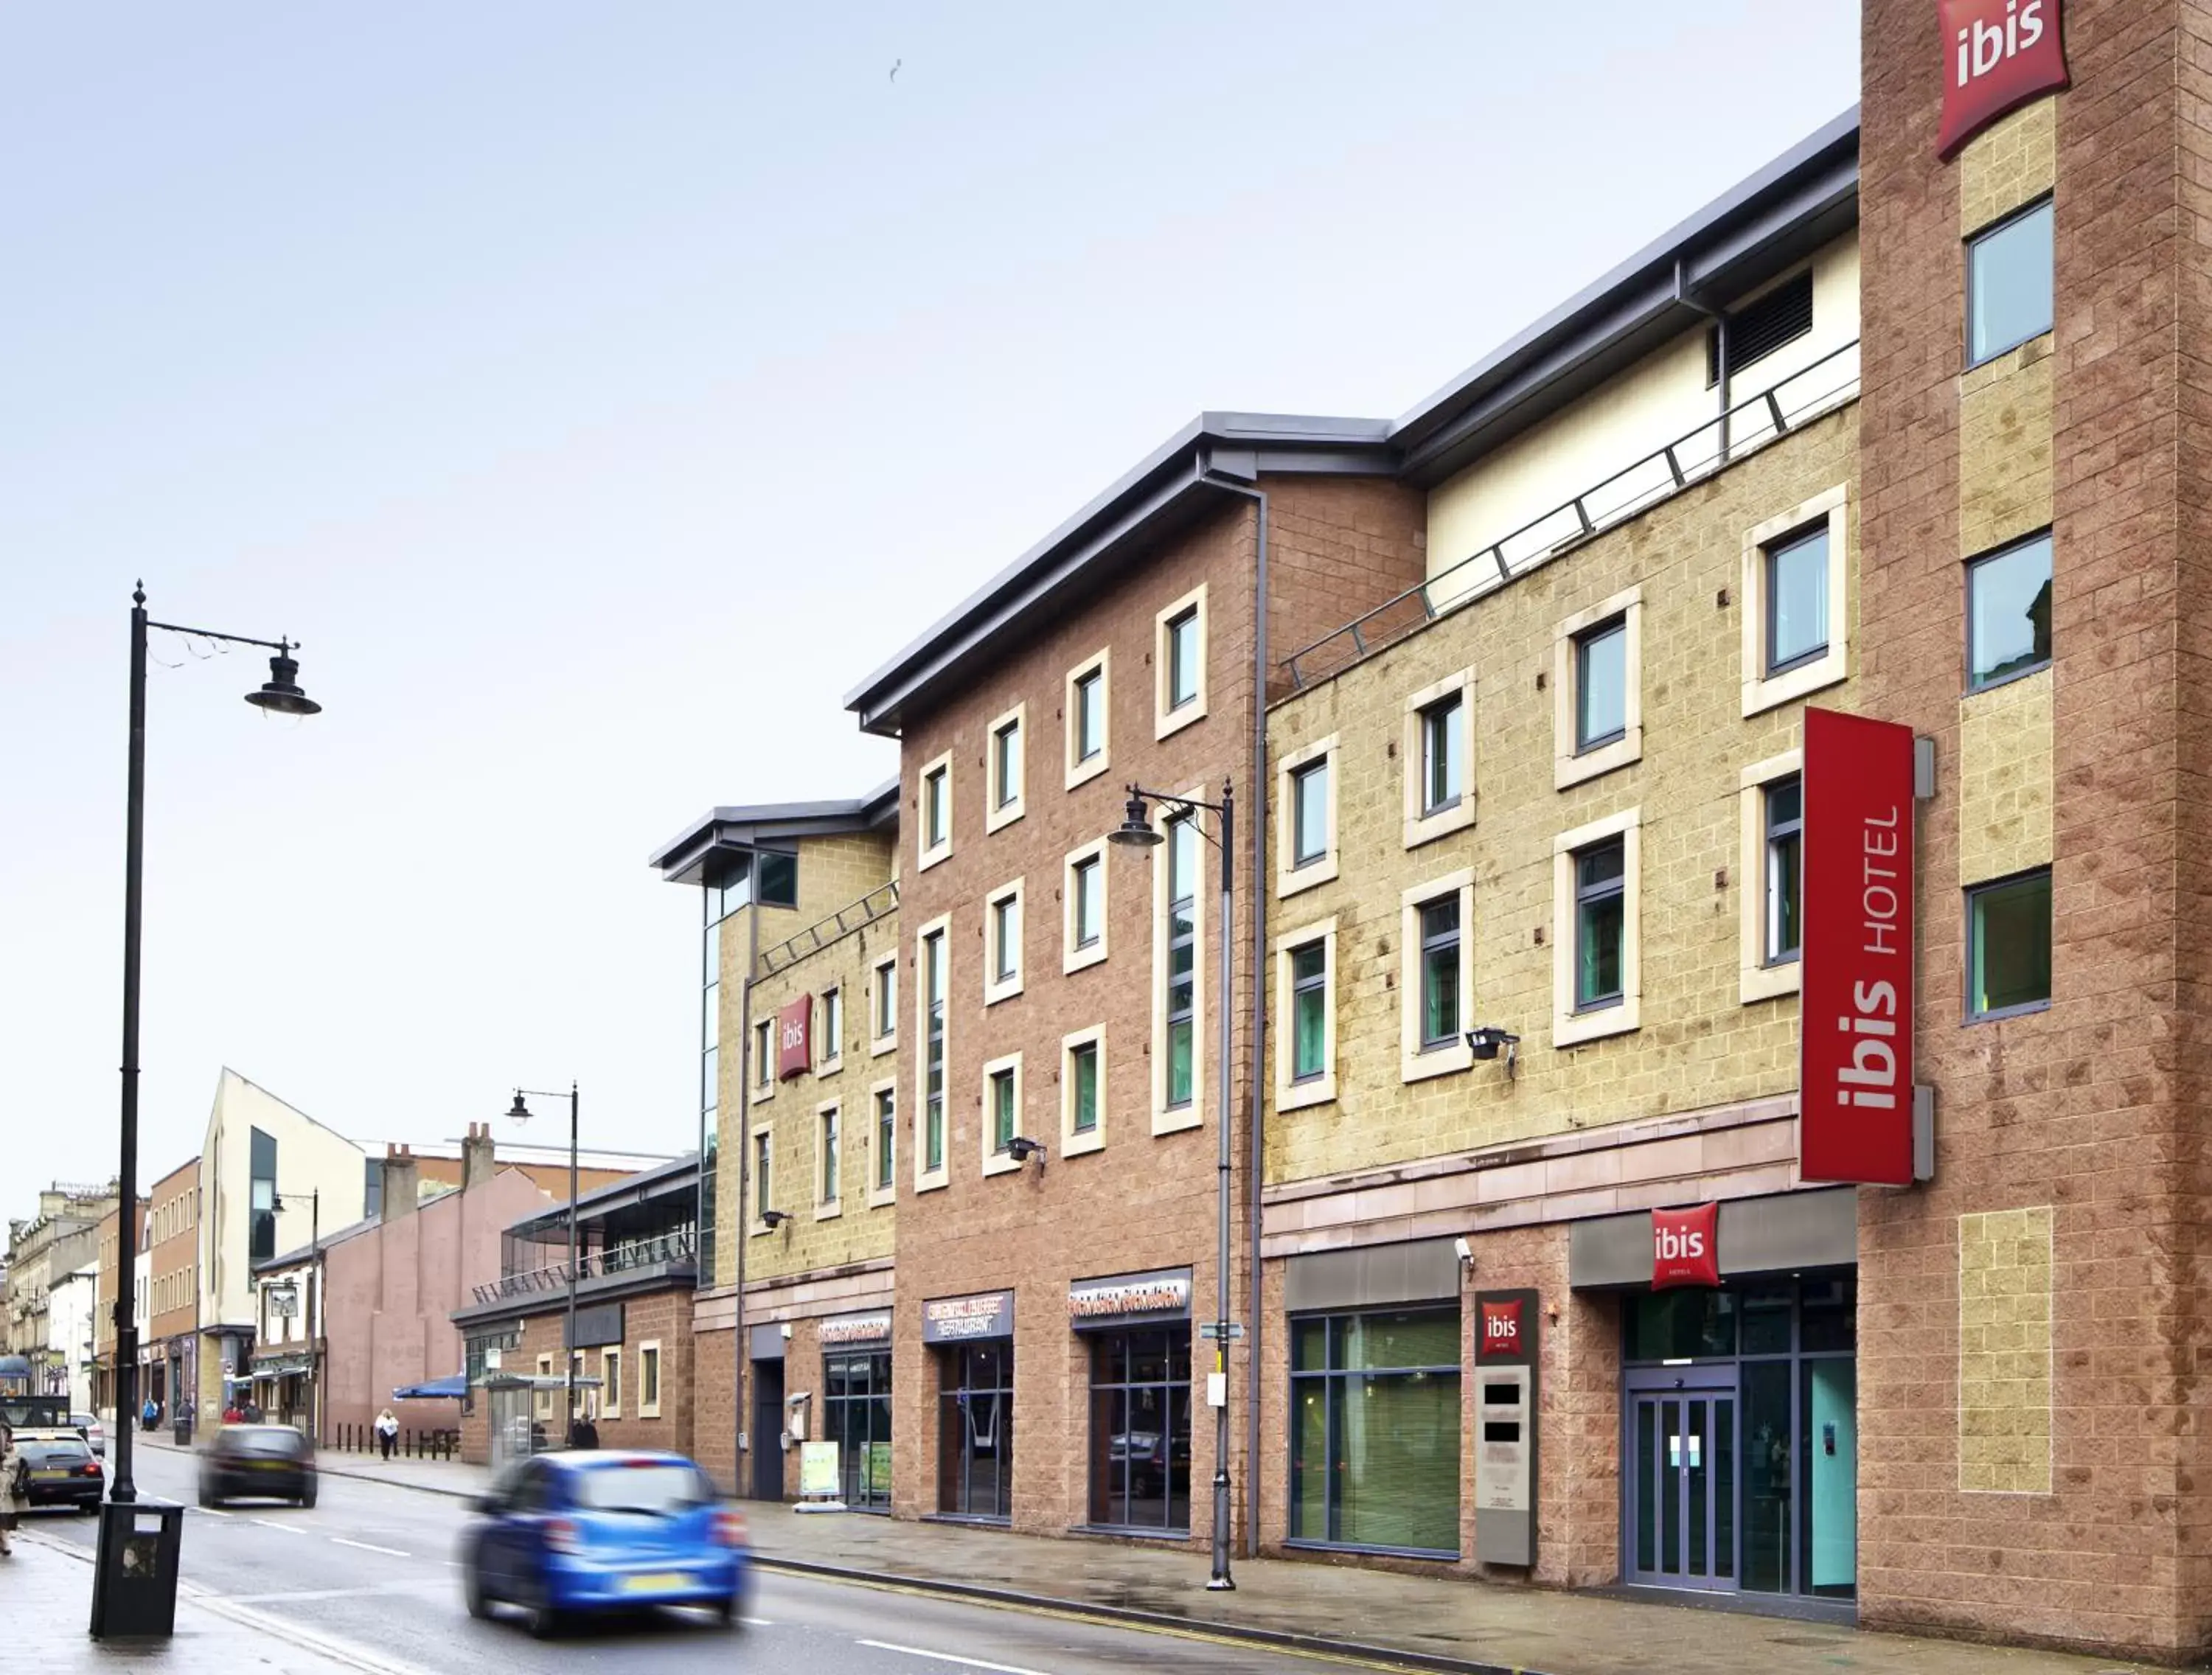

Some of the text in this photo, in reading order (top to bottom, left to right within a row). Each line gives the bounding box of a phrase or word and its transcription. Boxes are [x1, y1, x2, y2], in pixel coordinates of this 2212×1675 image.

[1958, 0, 2043, 87] ibis
[1837, 804, 1898, 1109] ibis HOTEL
[782, 1019, 803, 1051] ibis
[1655, 1225, 1704, 1259] ibis
[1488, 1314, 1517, 1337] ibis
